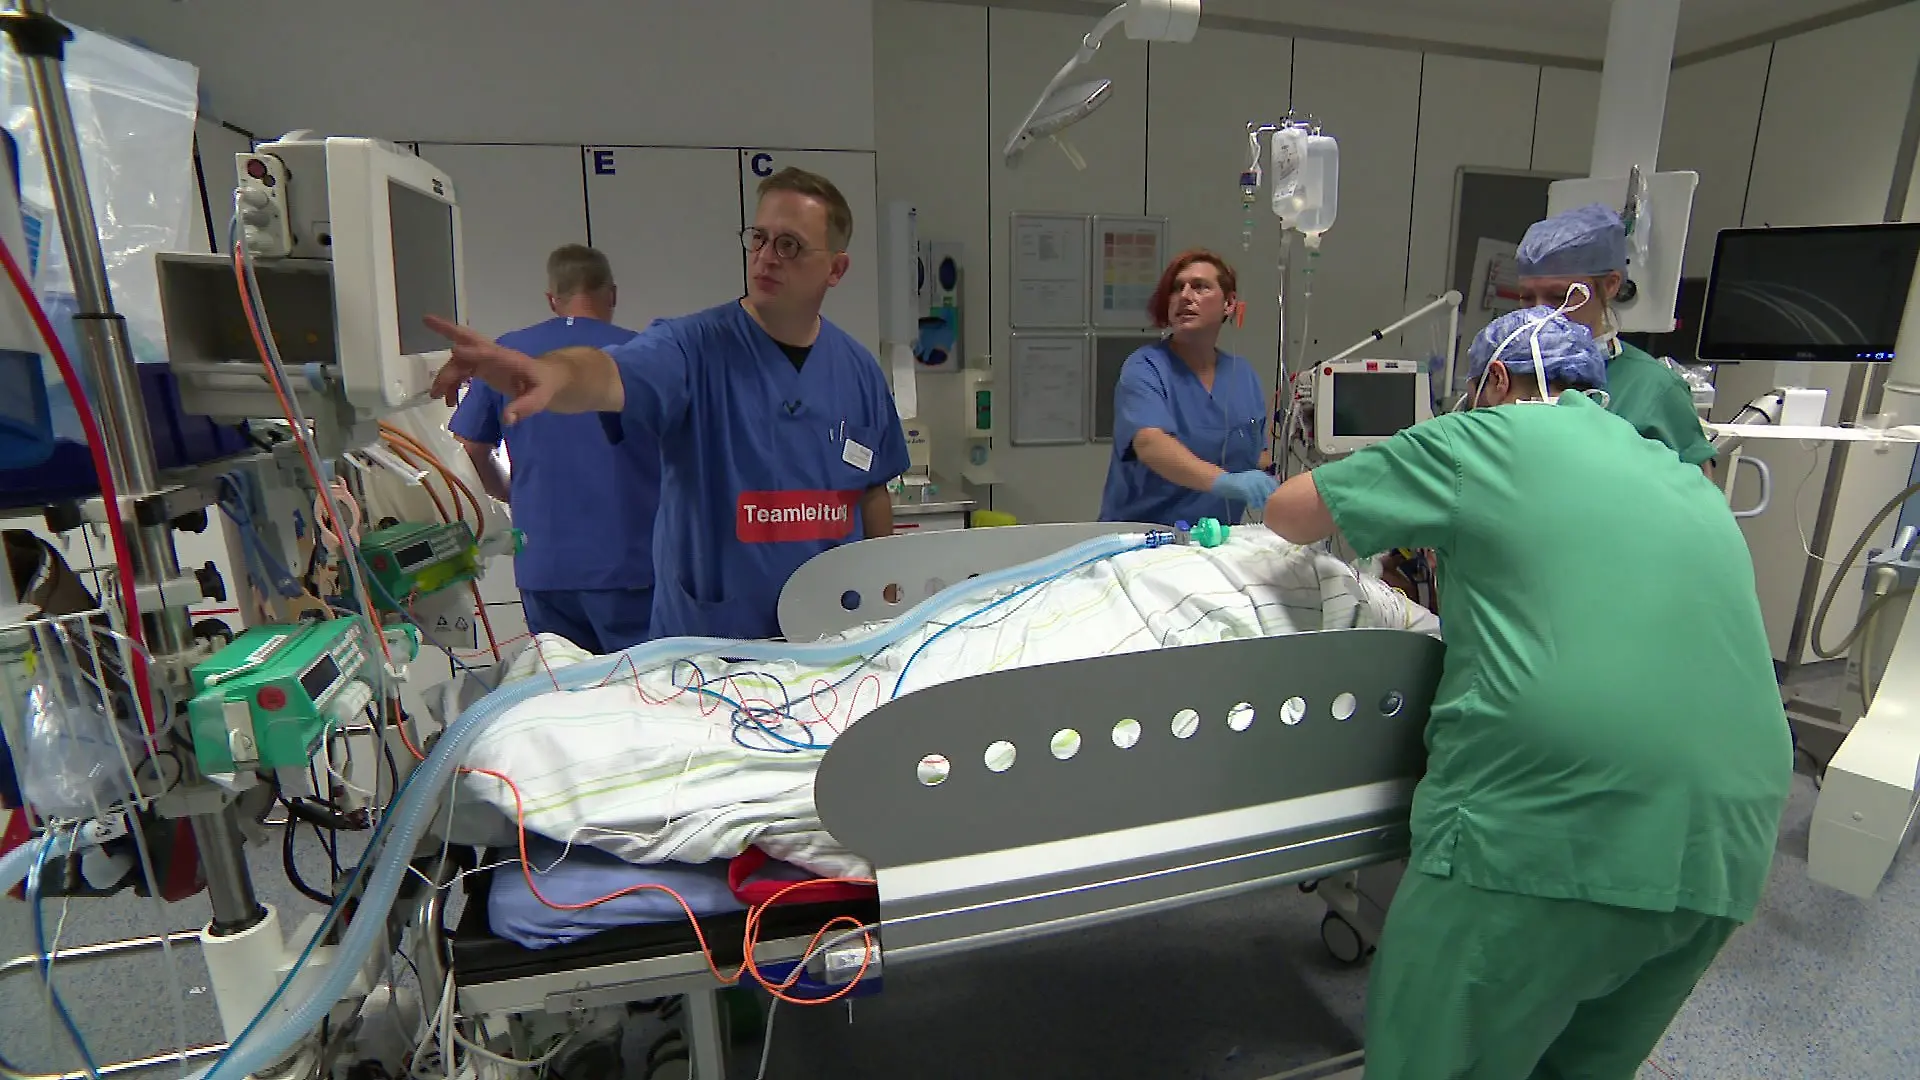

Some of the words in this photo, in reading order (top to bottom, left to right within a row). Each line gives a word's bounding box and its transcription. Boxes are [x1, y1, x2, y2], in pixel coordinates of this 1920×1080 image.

[594, 151, 616, 175] E
[751, 153, 773, 177] C
[743, 503, 848, 523] Teamleitu
